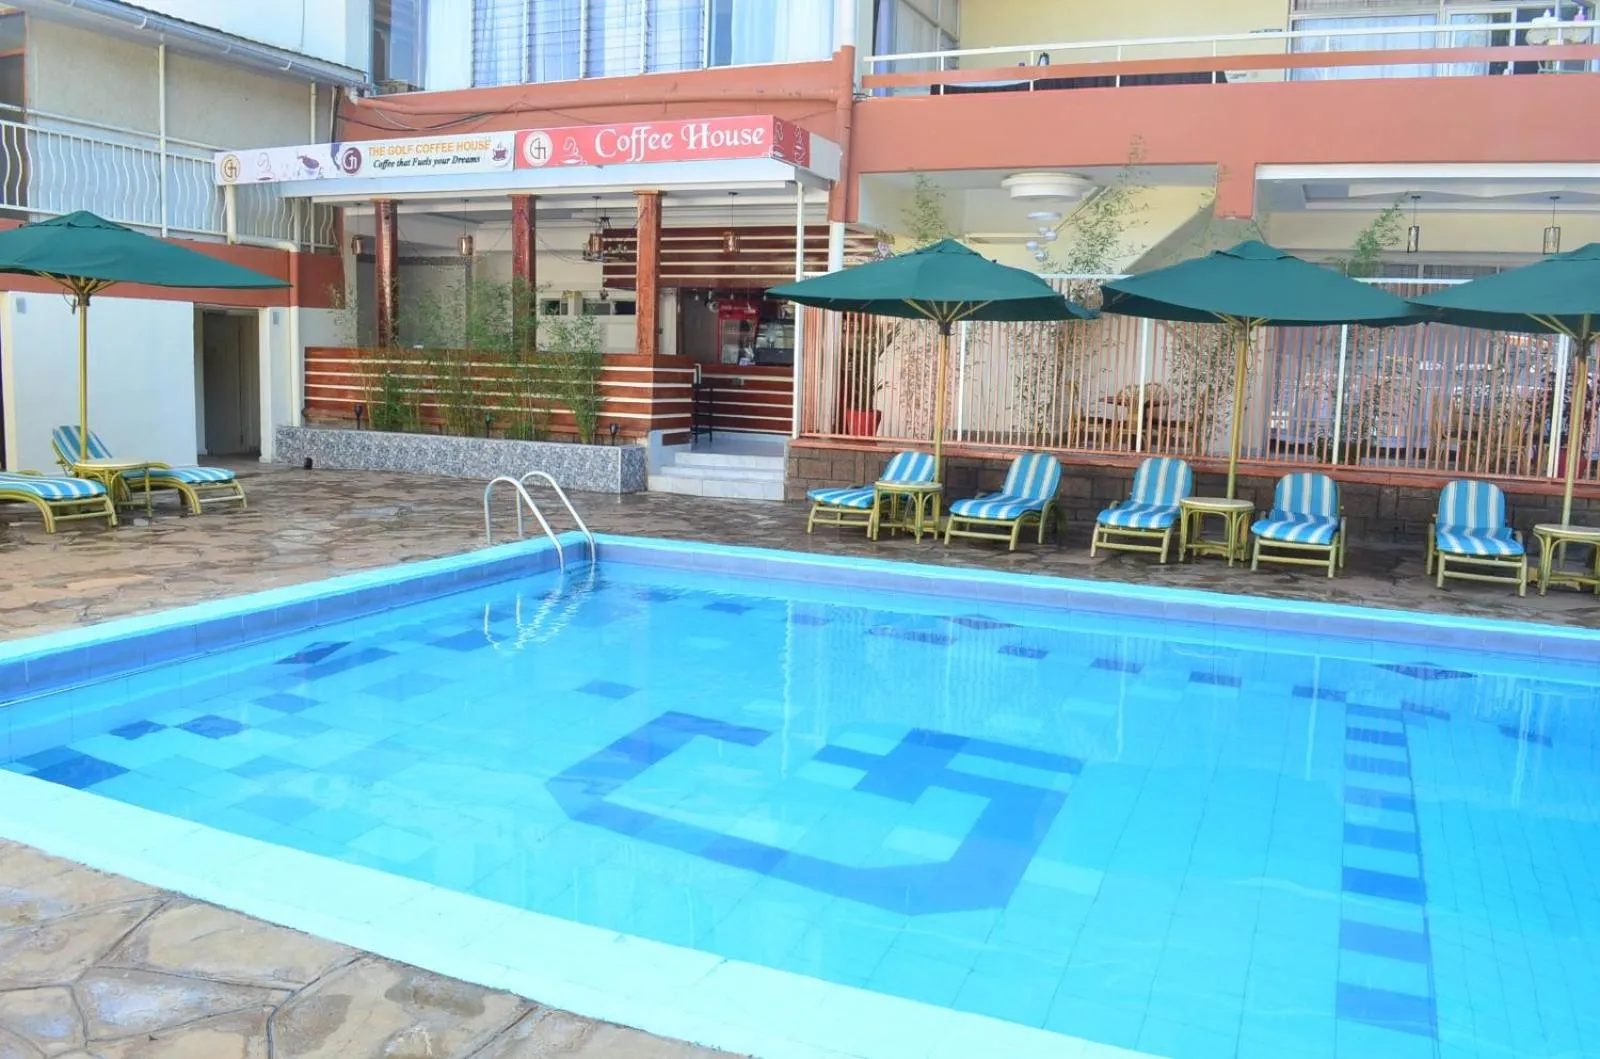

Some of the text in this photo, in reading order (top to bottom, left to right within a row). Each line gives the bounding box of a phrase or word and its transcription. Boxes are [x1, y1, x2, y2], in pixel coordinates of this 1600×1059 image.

[369, 140, 491, 157] THE GOLF COFFEE HOUSE
[595, 123, 766, 161] Coffee House
[373, 156, 480, 170] Coffee that Fuels your Dreams
